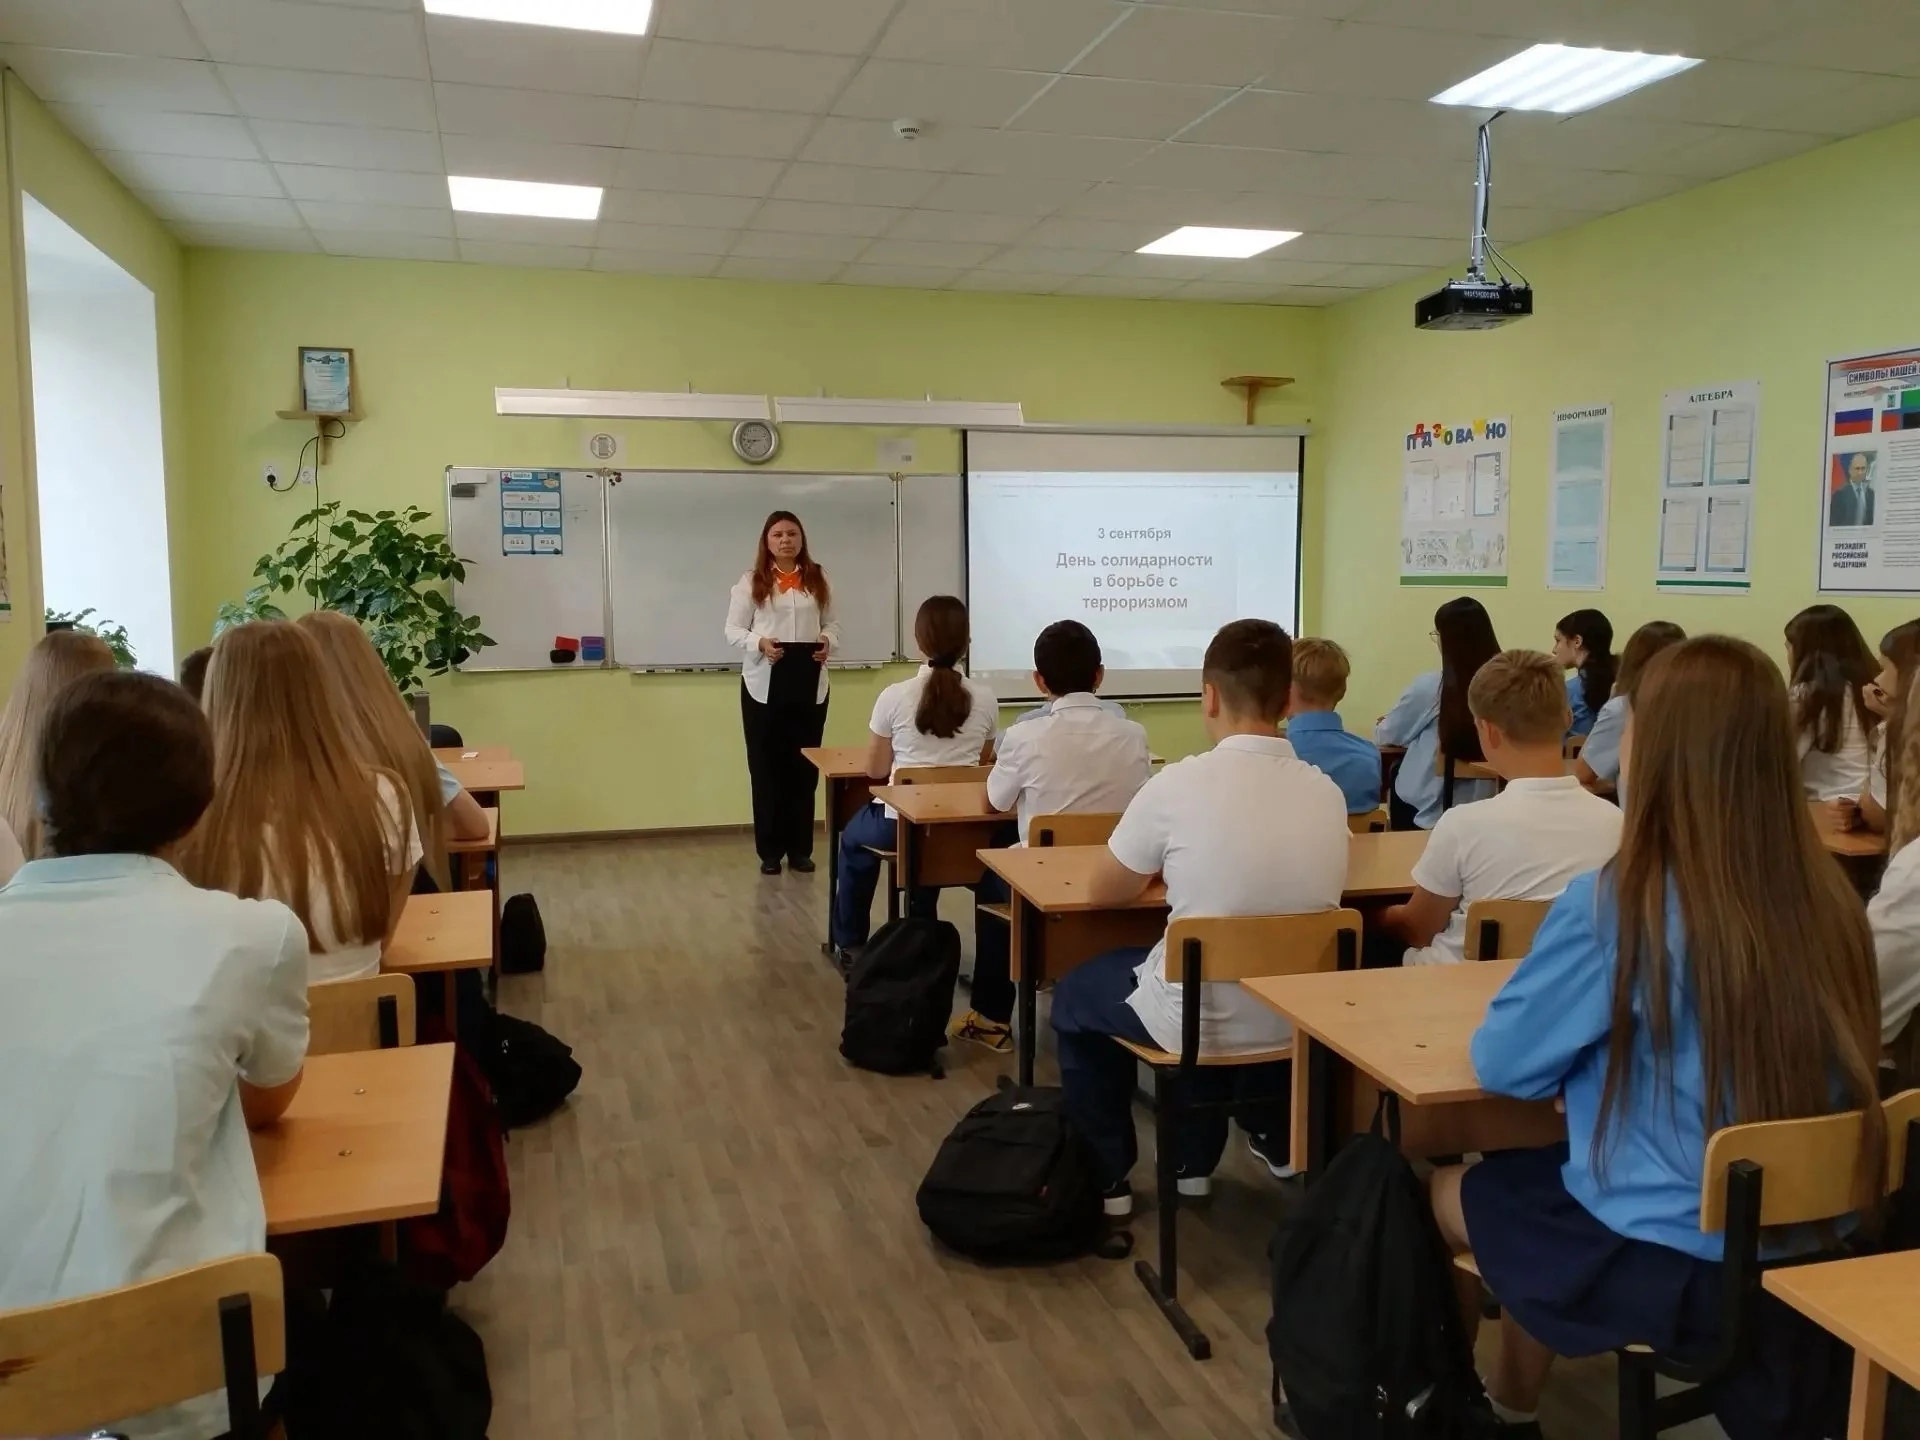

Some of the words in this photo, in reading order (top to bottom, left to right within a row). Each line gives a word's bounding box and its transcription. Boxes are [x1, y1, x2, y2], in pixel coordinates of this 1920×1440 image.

[1848, 368, 1889, 384] СИМВОЛЫ
[1890, 362, 1917, 377] НАШЕЙ
[1688, 389, 1734, 404] АЛГЕБРА
[1556, 407, 1607, 422] ИНФОРМАЦИЯ
[1098, 527, 1105, 539] 3
[1109, 527, 1172, 542] сентября
[1834, 542, 1867, 550] ПРЕЗИДЕНТ
[1056, 552, 1096, 569] День
[1101, 555, 1213, 569] солидарности
[1093, 576, 1102, 588] в
[1106, 573, 1165, 591] борьбе
[1169, 576, 1179, 588] с
[1082, 597, 1188, 612] терроризмом
